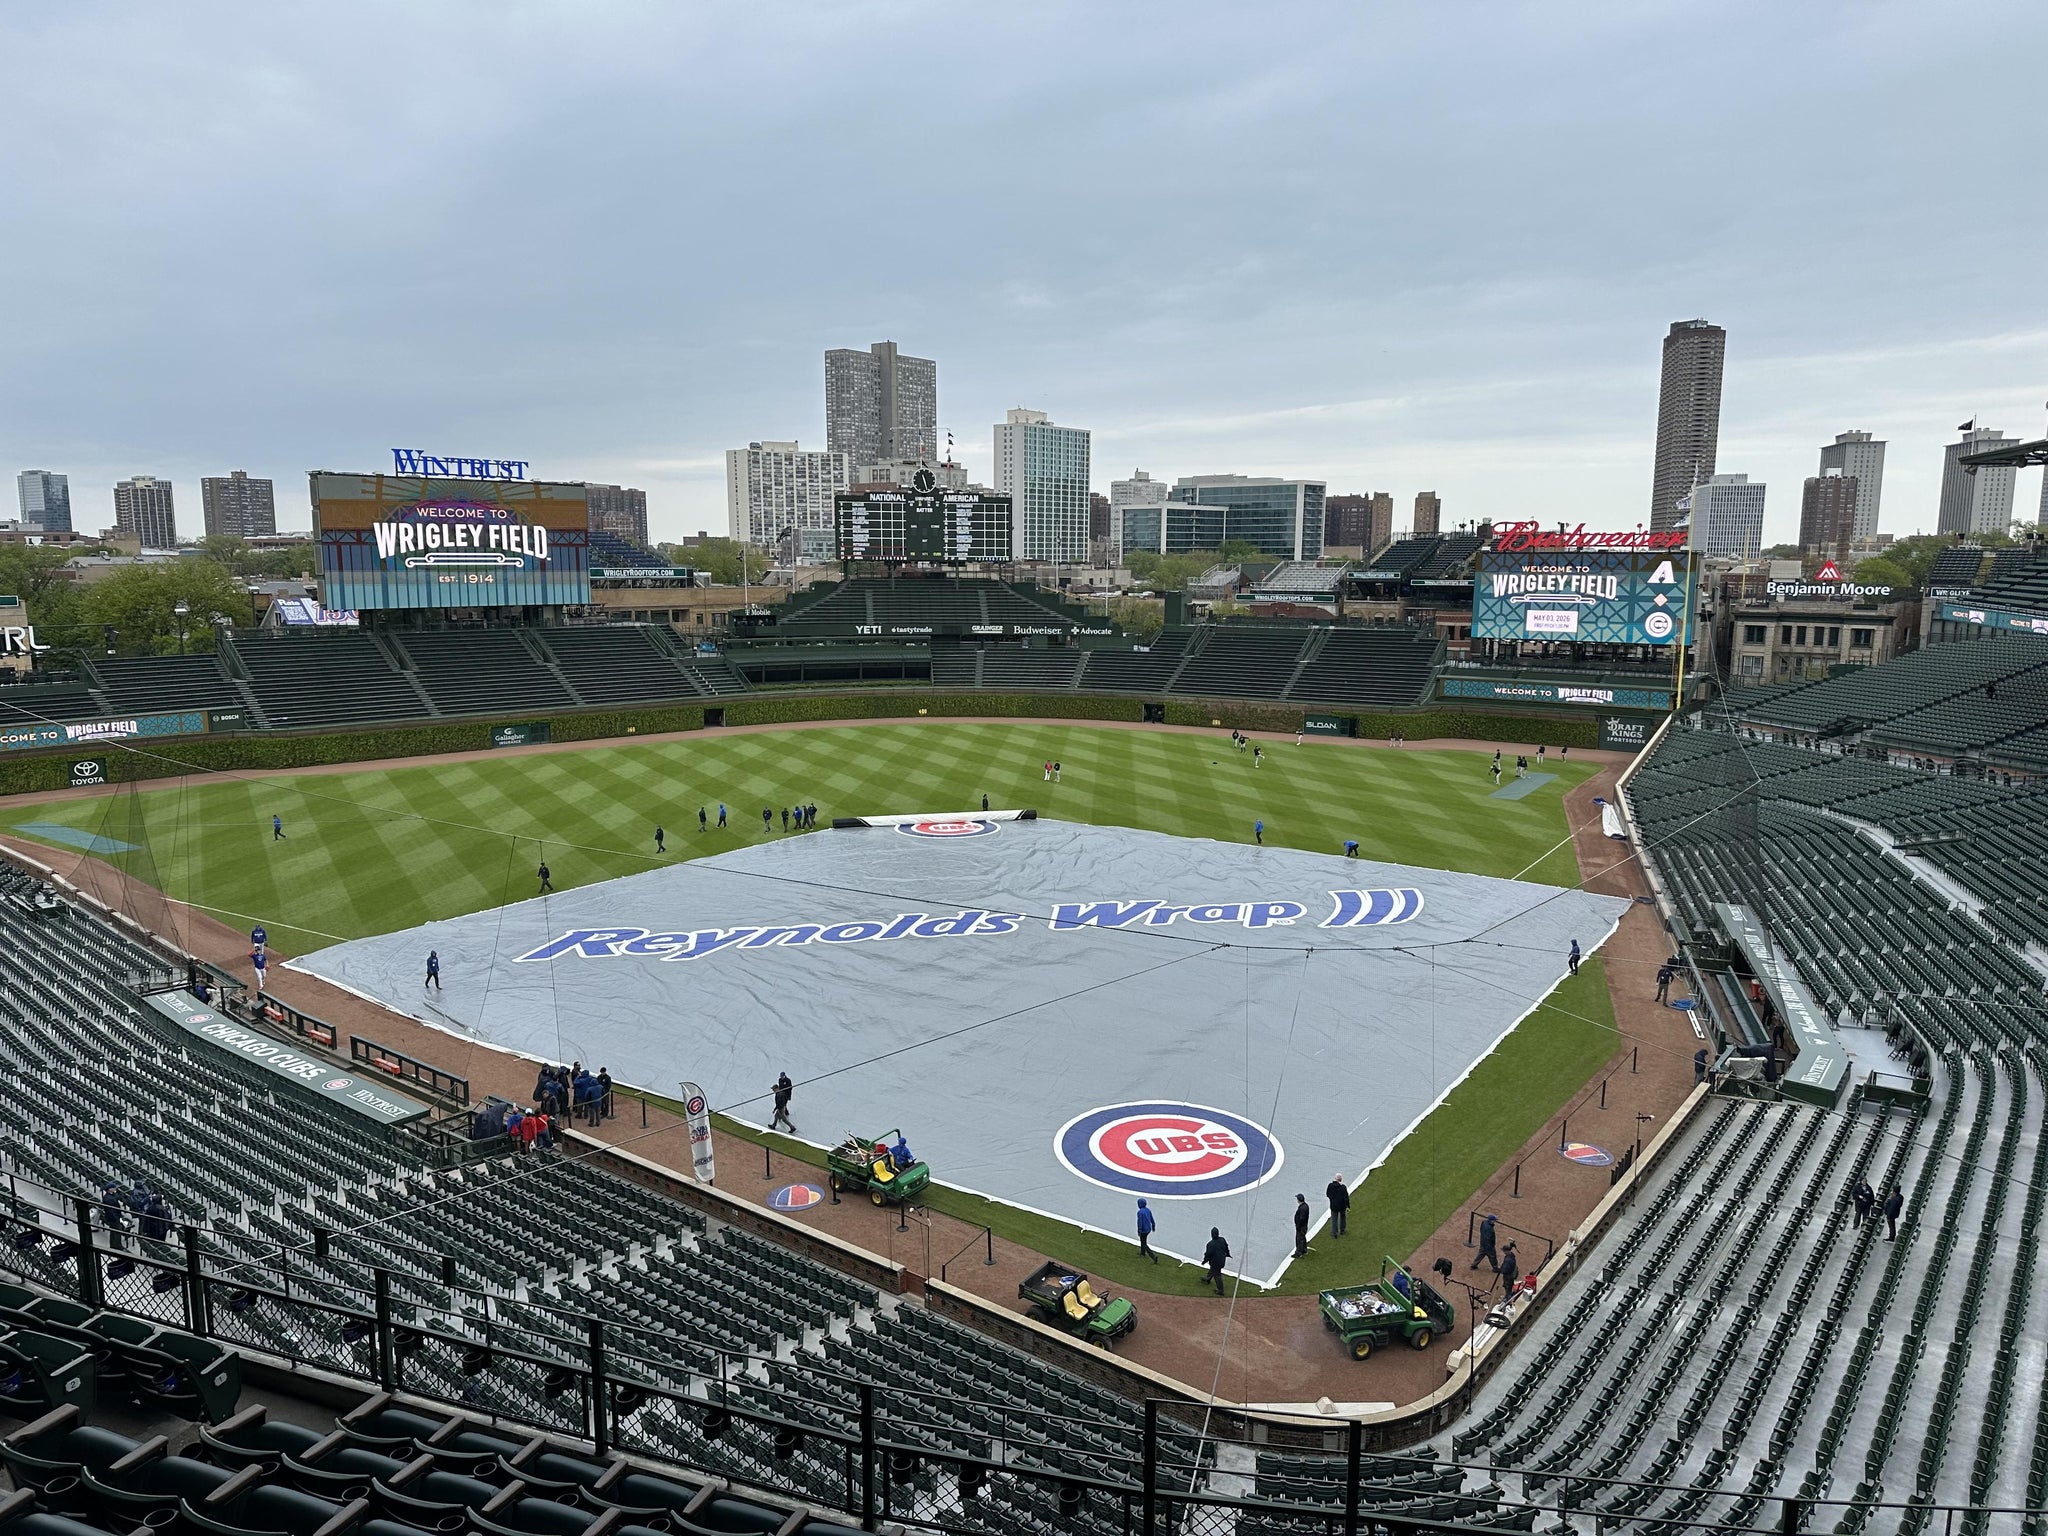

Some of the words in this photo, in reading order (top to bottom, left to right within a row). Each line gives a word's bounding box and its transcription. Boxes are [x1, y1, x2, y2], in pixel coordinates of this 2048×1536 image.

[391, 448, 529, 480] WINTRUST
[869, 493, 907, 502] NATIONAL
[942, 494, 979, 503] AMERICAN
[416, 507, 485, 519] WELCOME
[489, 508, 508, 519] TO
[1491, 520, 1689, 551] Budweiser
[372, 522, 485, 560] WRIGLEY
[488, 523, 549, 561] FIELD
[603, 569, 675, 577] WRIGLEYROOFTOPS.COM
[1521, 565, 1572, 573] WELCOME
[1576, 565, 1591, 573] TO
[438, 574, 459, 584] EST.
[463, 573, 495, 584] 1914
[1492, 573, 1566, 598] WRIGLEY
[1571, 574, 1618, 600] FIELD
[1766, 582, 1836, 597] Benjamin
[1840, 583, 1891, 596] Moore
[751, 608, 772, 616] Mobile
[1533, 614, 1546, 622] MAY
[1556, 614, 1571, 622] 2026
[855, 625, 882, 635] YETI
[896, 626, 933, 635] tastytrade
[1080, 627, 1113, 635] Advocate
[1494, 687, 1537, 696] WELCOME
[1557, 687, 1592, 699] WRIGLEY
[1592, 689, 1614, 702] FIELD
[40, 731, 58, 740] TO
[65, 722, 111, 740] WRIGLEY
[111, 720, 138, 734] FIELD
[1305, 721, 1337, 730] SLOAN
[1607, 721, 1645, 732] DRAFT
[494, 732, 525, 742] Gallagher
[1611, 730, 1643, 738] KINGS
[1606, 736, 1646, 744] SPORTSBOOK
[71, 776, 104, 786] TOYOTA
[511, 909, 1028, 963] Reynolds
[1048, 899, 1308, 931] Wrap
[200, 1023, 280, 1058] CHICAGO
[267, 1051, 327, 1081] CUBS
[352, 1088, 411, 1117] WINTRUST
[1099, 1117, 1239, 1177] CUBS
